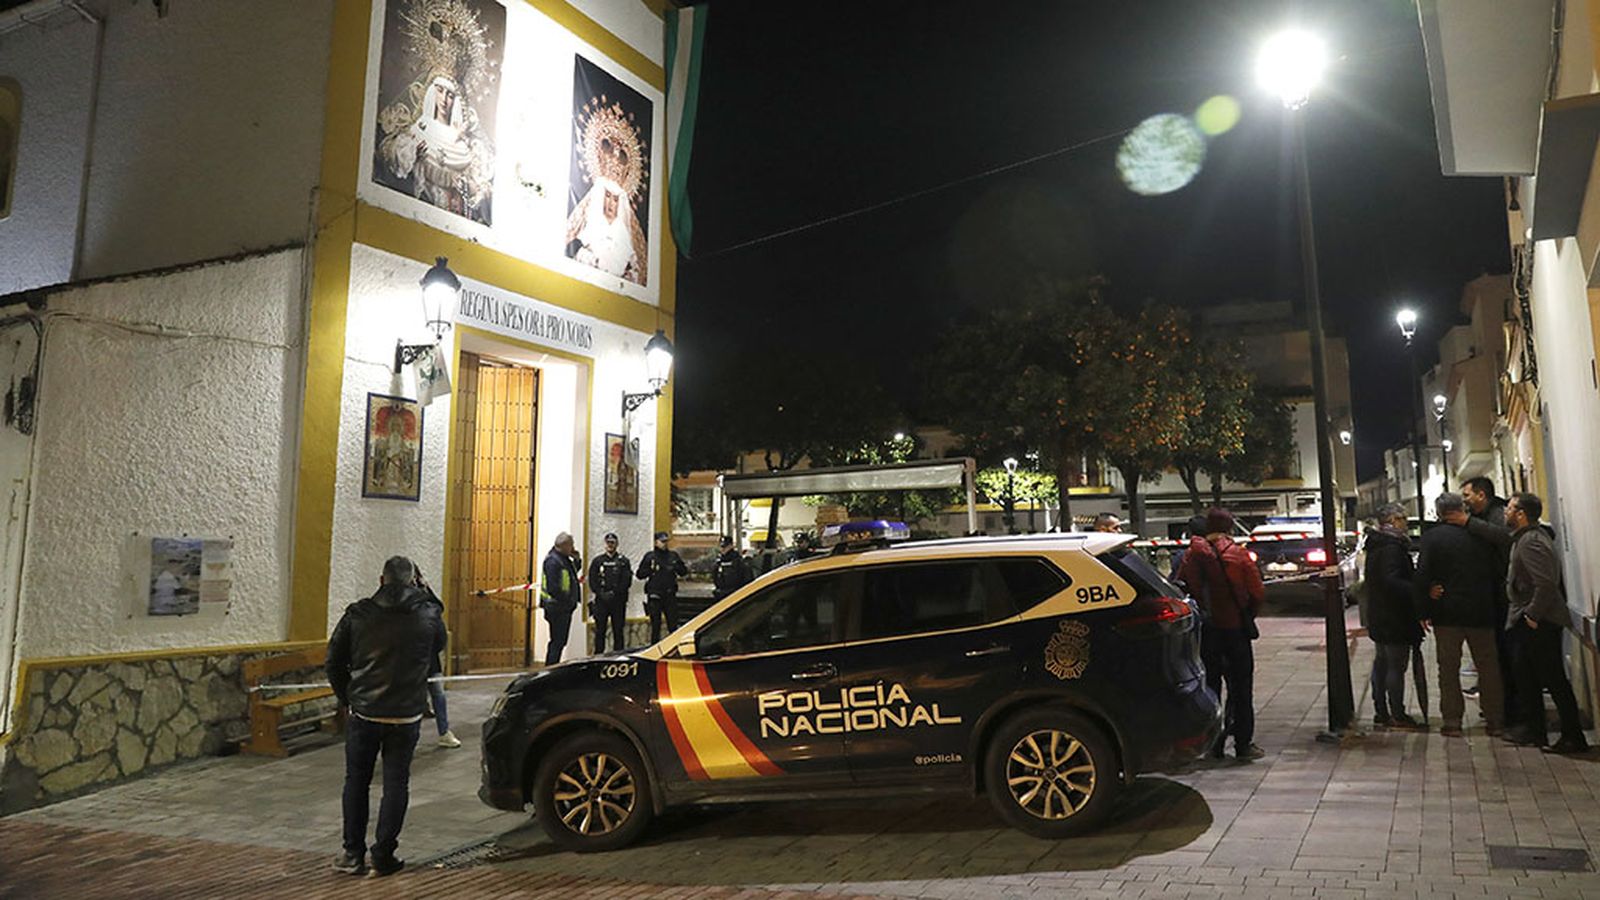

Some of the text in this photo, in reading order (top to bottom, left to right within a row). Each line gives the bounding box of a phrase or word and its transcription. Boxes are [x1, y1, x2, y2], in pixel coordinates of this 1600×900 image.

[460, 289, 593, 350] REGINA SPES ORA PRO NOBIS
[1075, 584, 1120, 604] 9BA
[606, 662, 639, 678] 091
[758, 680, 912, 716] POLICÍA
[759, 703, 962, 739] NACIONAL
[914, 752, 963, 766] @policia
